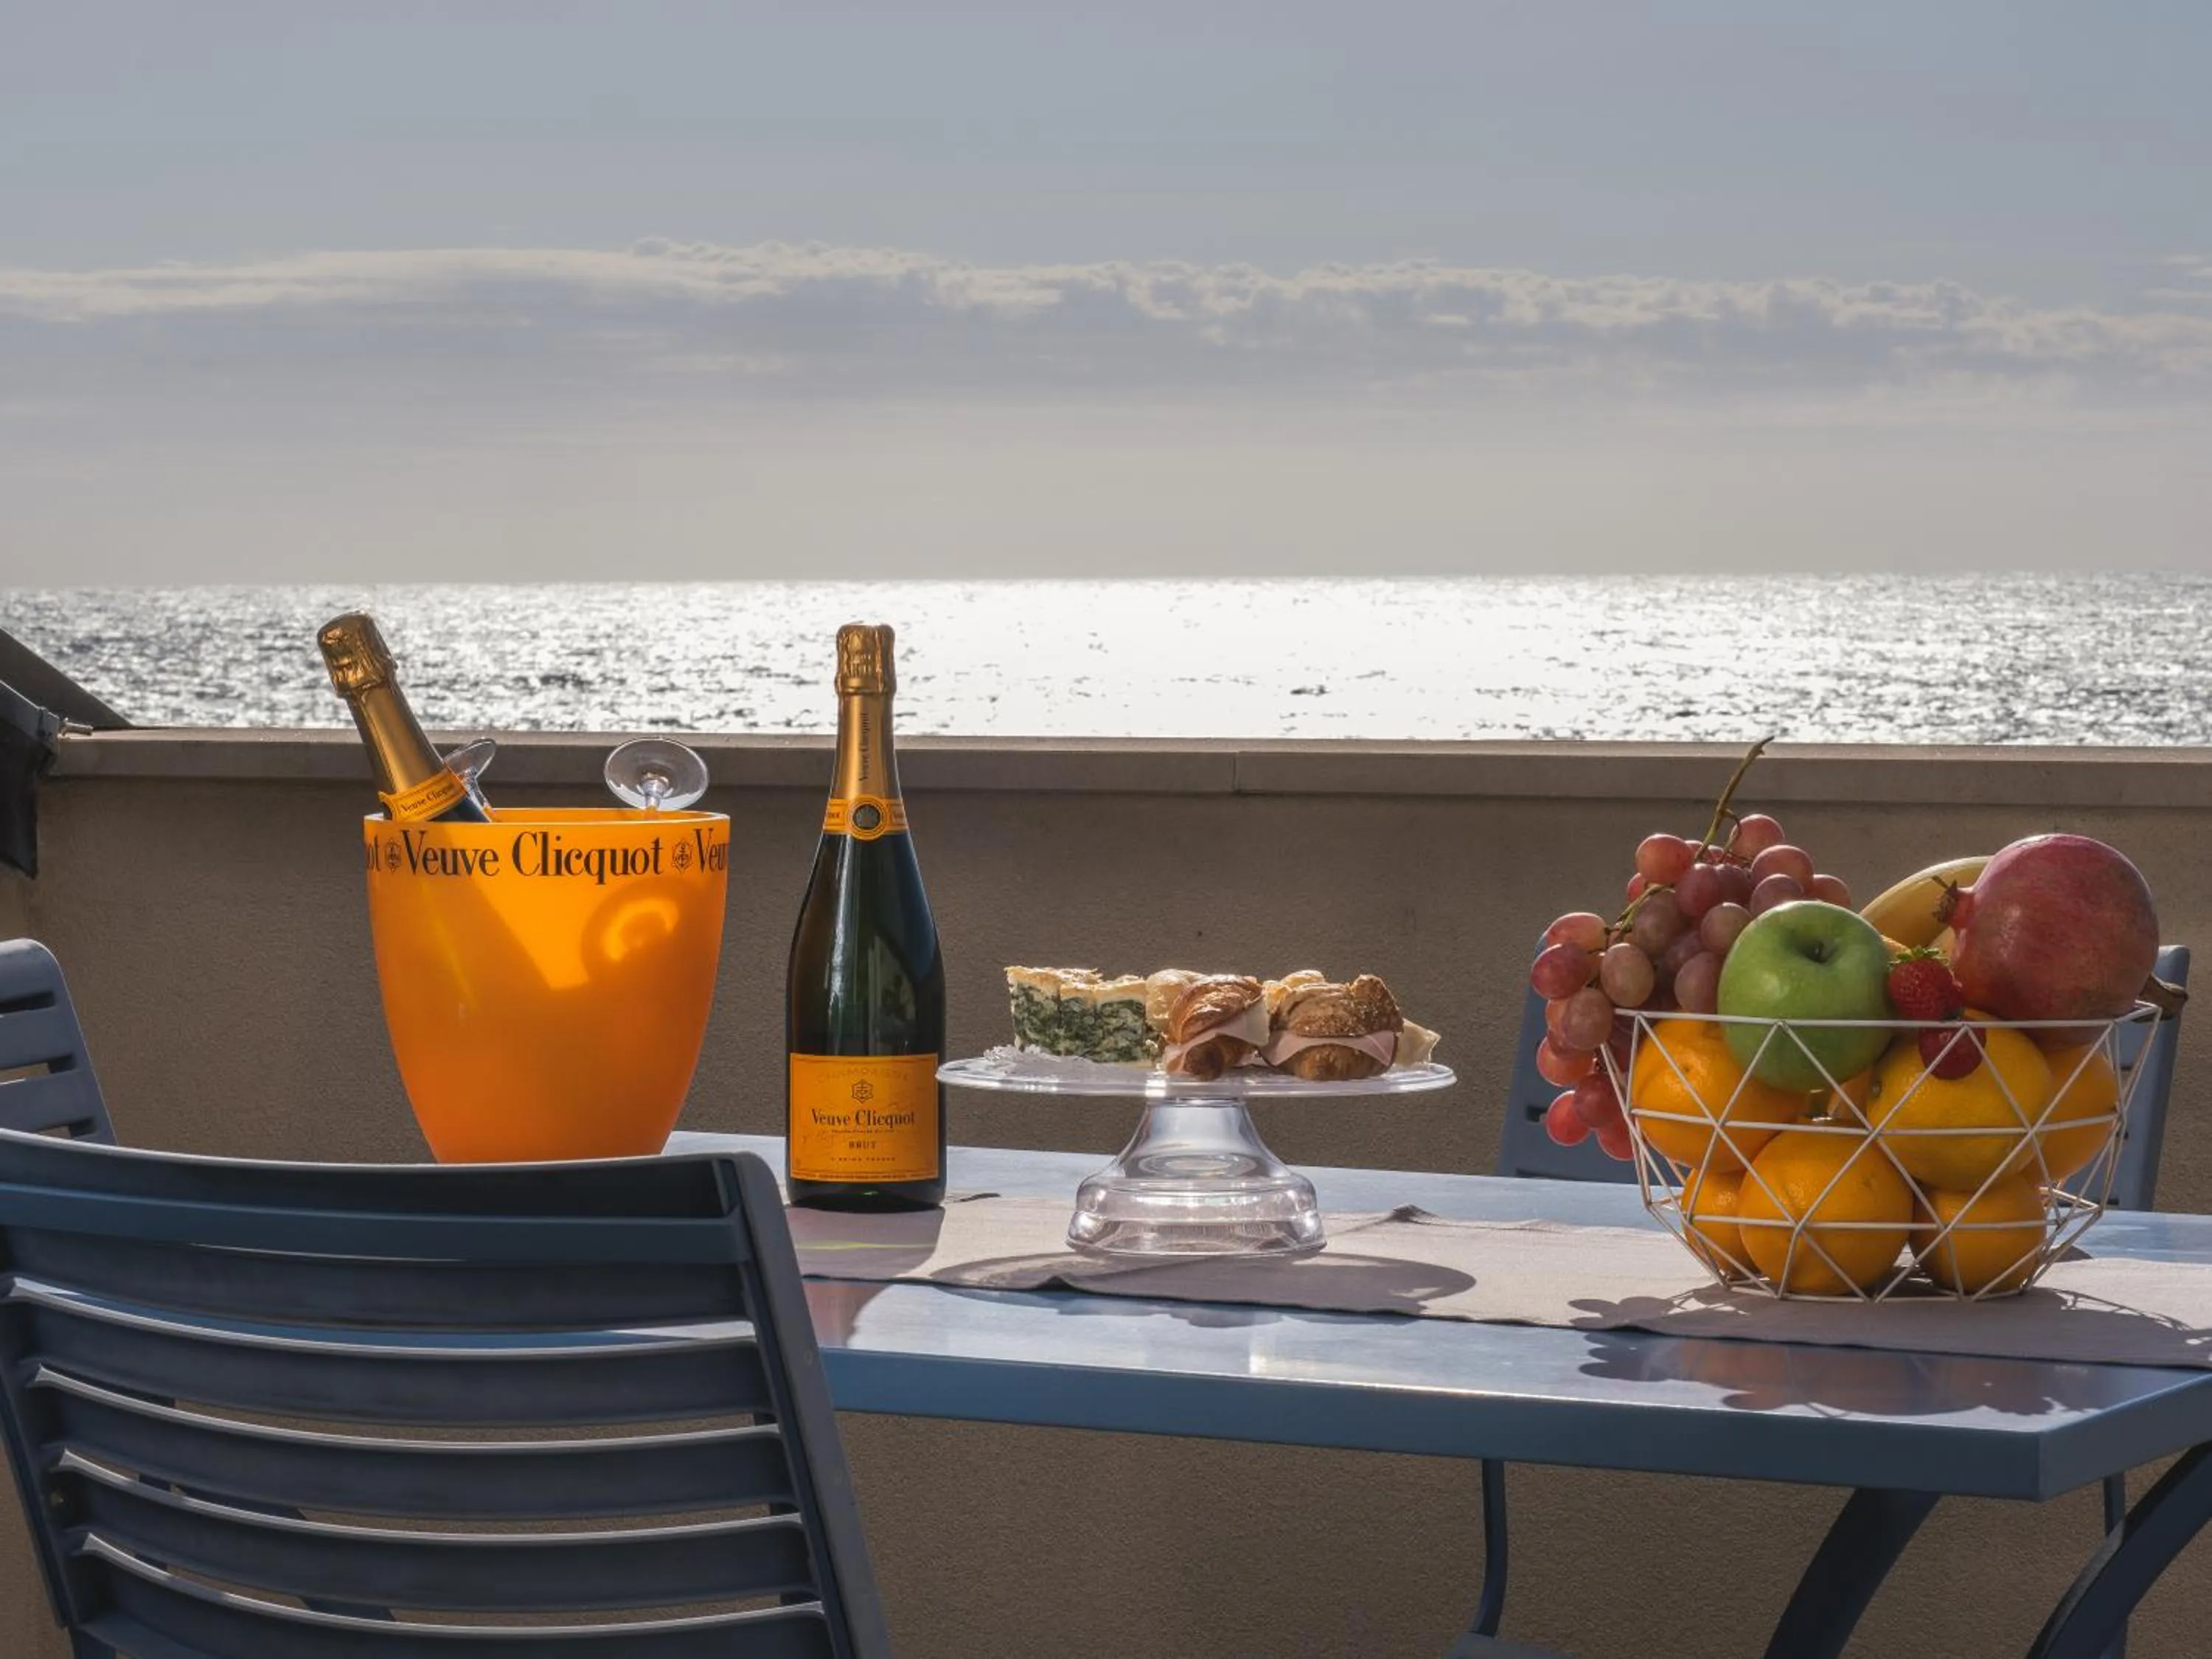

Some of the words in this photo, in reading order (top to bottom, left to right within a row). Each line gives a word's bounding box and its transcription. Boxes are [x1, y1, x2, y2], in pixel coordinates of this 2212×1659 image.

[401, 830, 500, 877] Veuve
[512, 831, 664, 885] Clicquot
[812, 1108, 851, 1126] Veuve
[855, 1109, 914, 1129] Clicquot
